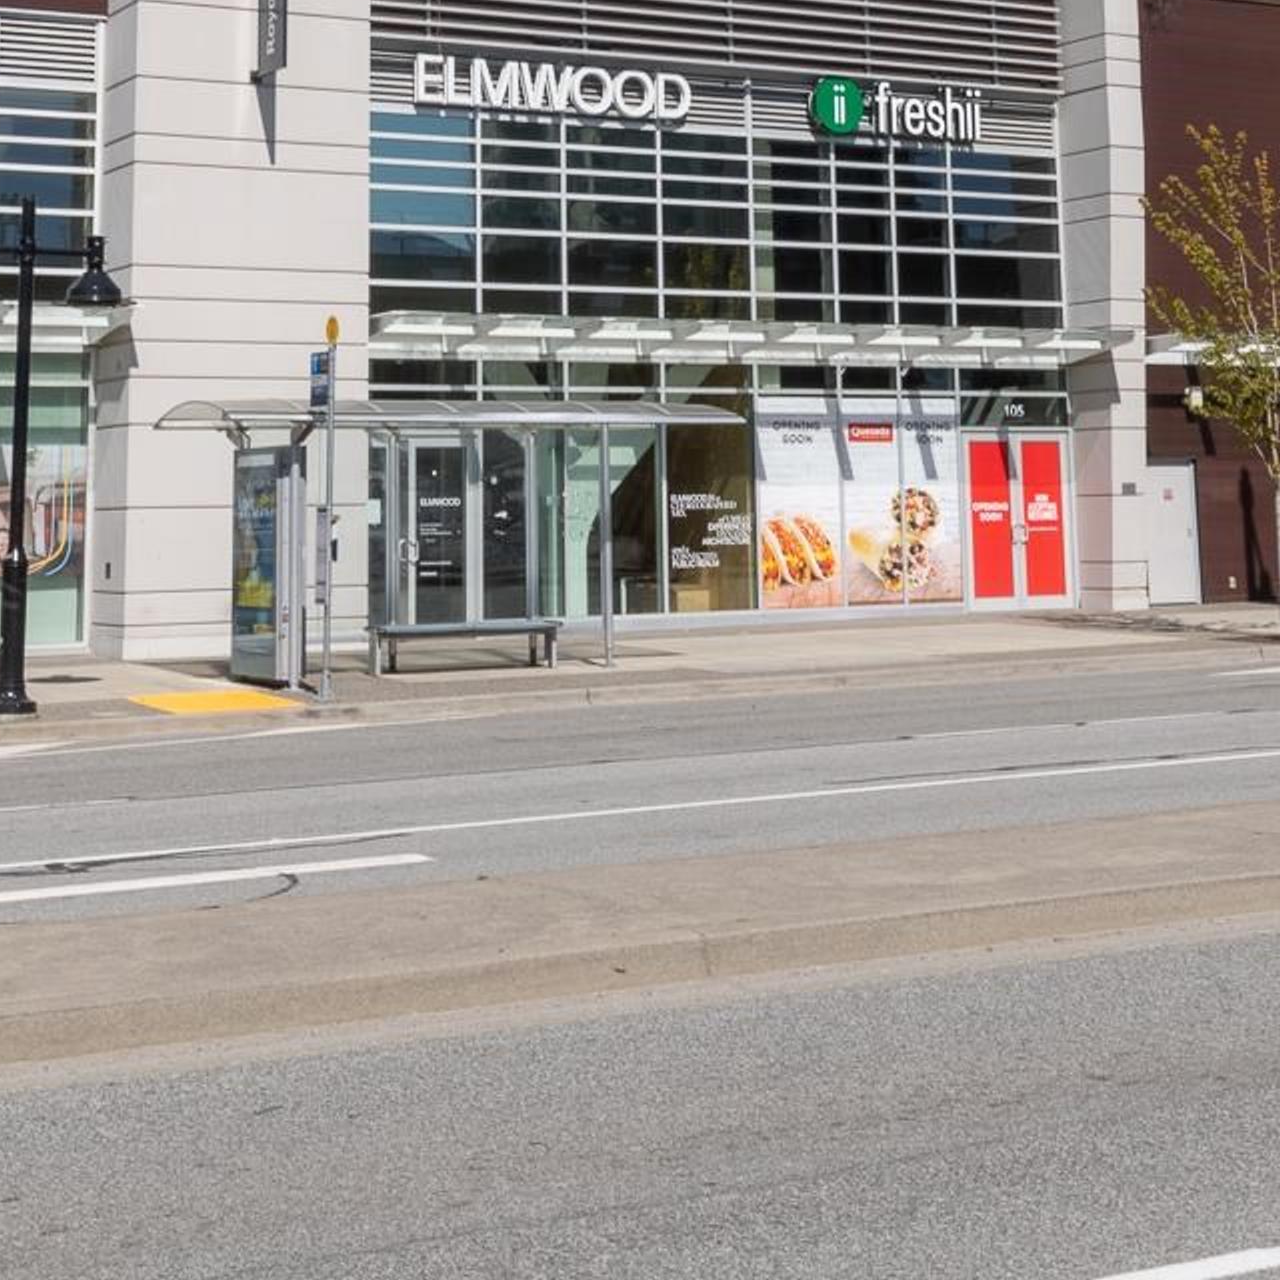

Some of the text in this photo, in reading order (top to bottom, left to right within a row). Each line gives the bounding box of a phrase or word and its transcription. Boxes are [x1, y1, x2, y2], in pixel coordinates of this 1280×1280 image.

[413, 53, 692, 121] ELMWOOD
[875, 81, 983, 142] freshii
[1004, 404, 1025, 417] 105
[773, 421, 821, 431] OPENING
[420, 497, 461, 507] ELMWOOD
